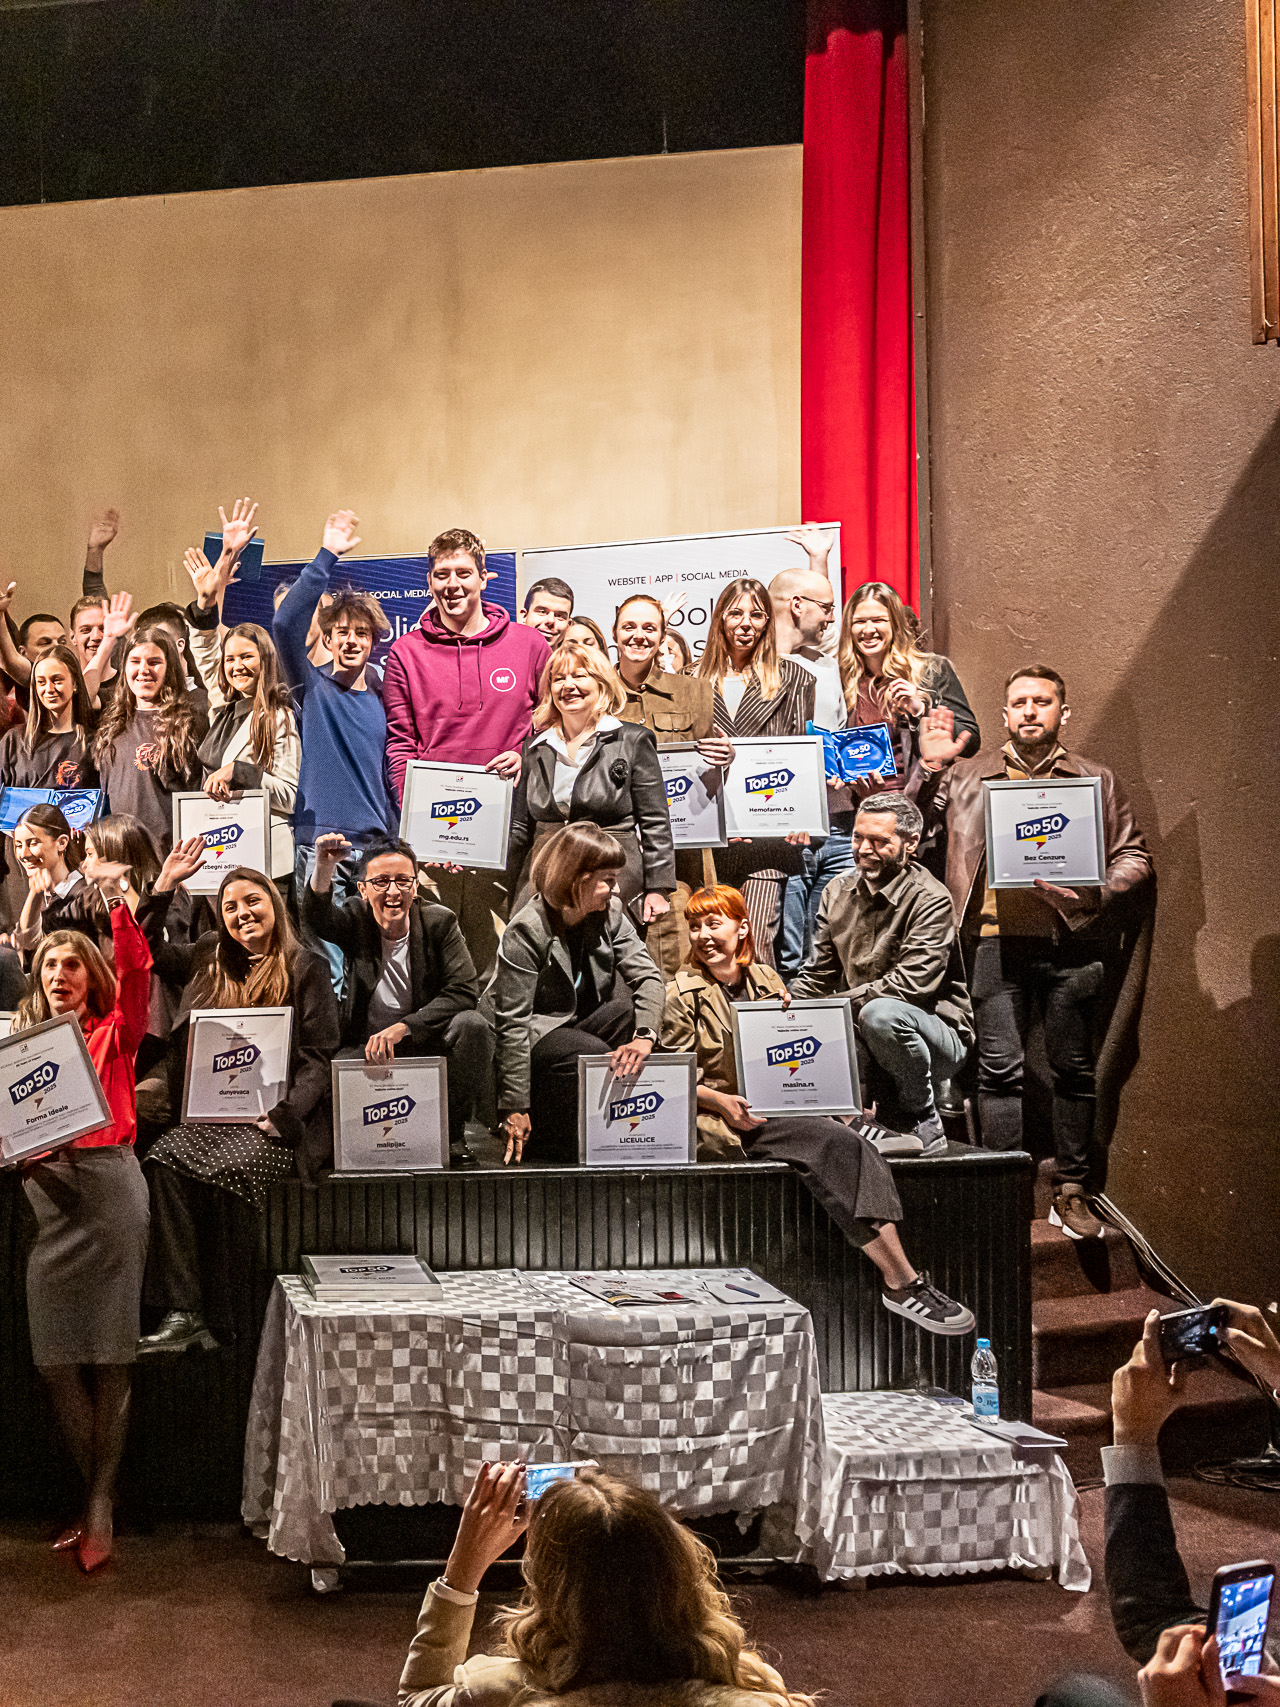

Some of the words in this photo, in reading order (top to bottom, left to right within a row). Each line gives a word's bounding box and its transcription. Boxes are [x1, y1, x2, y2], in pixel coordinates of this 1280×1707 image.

[608, 576, 646, 587] WEBSITE
[654, 574, 673, 584] APP
[681, 570, 715, 582] SOCIAL
[719, 569, 749, 579] MEDIA
[370, 589, 402, 600] SOCIAL
[405, 589, 433, 599] MEDIA
[667, 778, 686, 796] 50
[769, 770, 789, 787] 50
[456, 800, 476, 814] 50
[1042, 816, 1063, 833] 50
[220, 826, 238, 843] 50
[438, 834, 469, 842] mg.edu.rs
[236, 1047, 255, 1065] 50
[793, 1039, 815, 1058] 50
[800, 1058, 815, 1066] 2025
[34, 1065, 54, 1087] 50
[43, 1082, 57, 1095] 2025
[389, 1099, 409, 1117] 50
[636, 1095, 657, 1113] 50
[25, 1111, 48, 1125] Forma
[48, 1104, 69, 1117] Ideale
[394, 1118, 408, 1126] 2025
[376, 1141, 406, 1149] malipijac
[619, 1136, 656, 1144] LICEULICE
